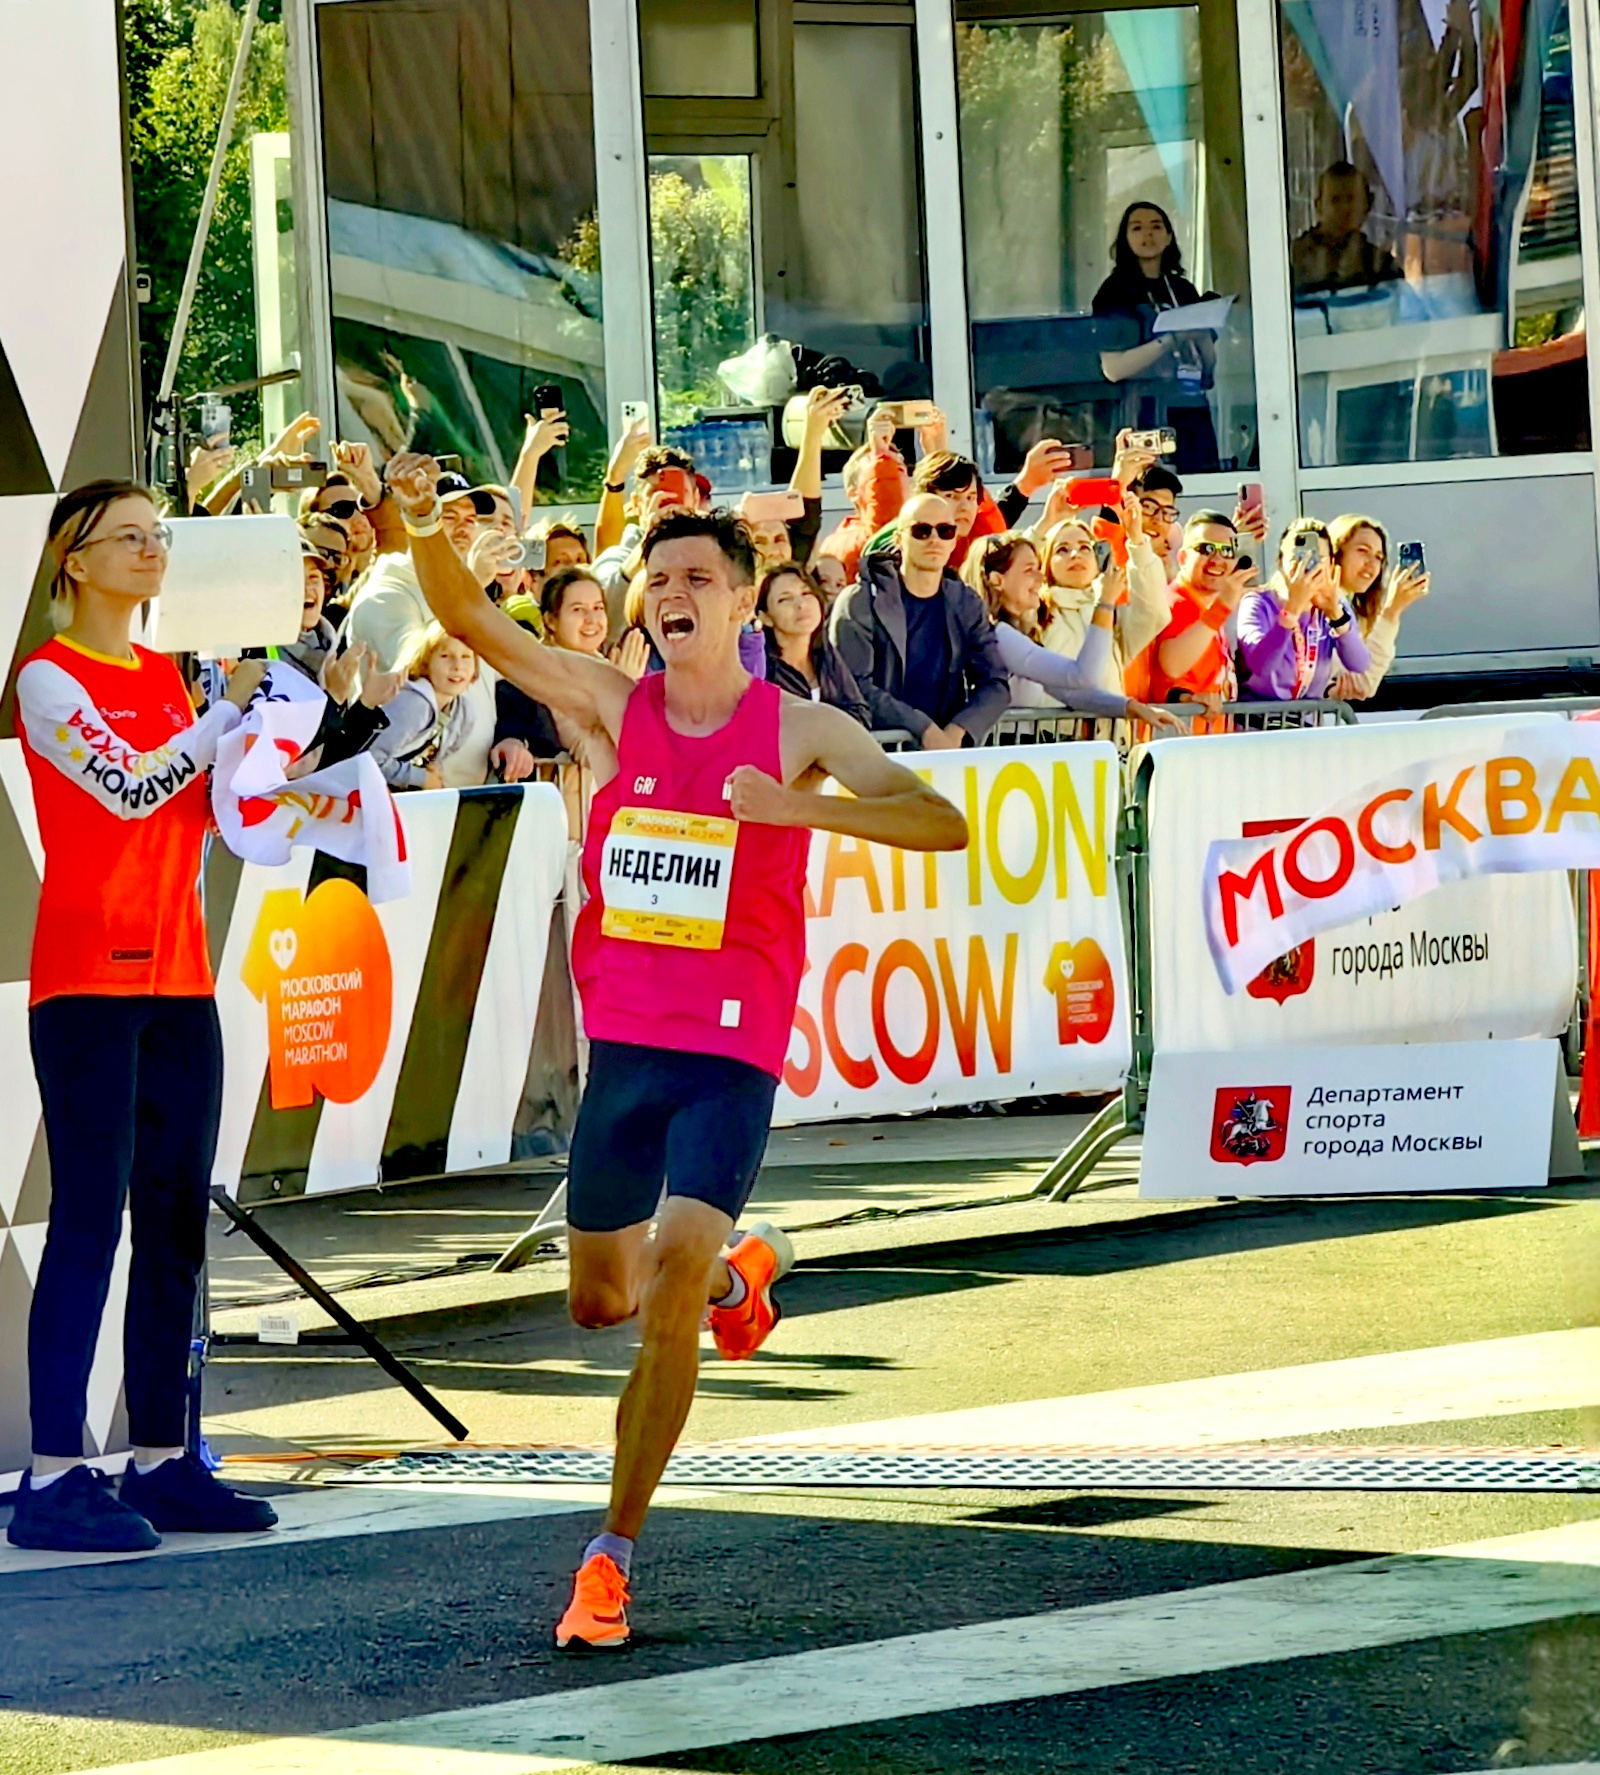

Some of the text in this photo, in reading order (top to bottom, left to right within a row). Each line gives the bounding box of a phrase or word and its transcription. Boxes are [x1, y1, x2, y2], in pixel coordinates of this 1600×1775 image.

[804, 759, 1108, 918] AHON
[1218, 756, 1600, 948] МОСКВА
[609, 847, 721, 888] НЕДЕЛИН
[651, 894, 658, 905] 3
[1332, 930, 1489, 984] города Москвы
[280, 967, 362, 997] МОСКОВСКИЙ
[281, 997, 342, 1021] МАРАФОН
[283, 1020, 334, 1043] MOSCOW
[285, 1042, 347, 1065] MARATHON
[1307, 1084, 1465, 1107] Департамент
[1306, 1113, 1386, 1133] спорта
[1303, 1134, 1483, 1158] города Москвы
